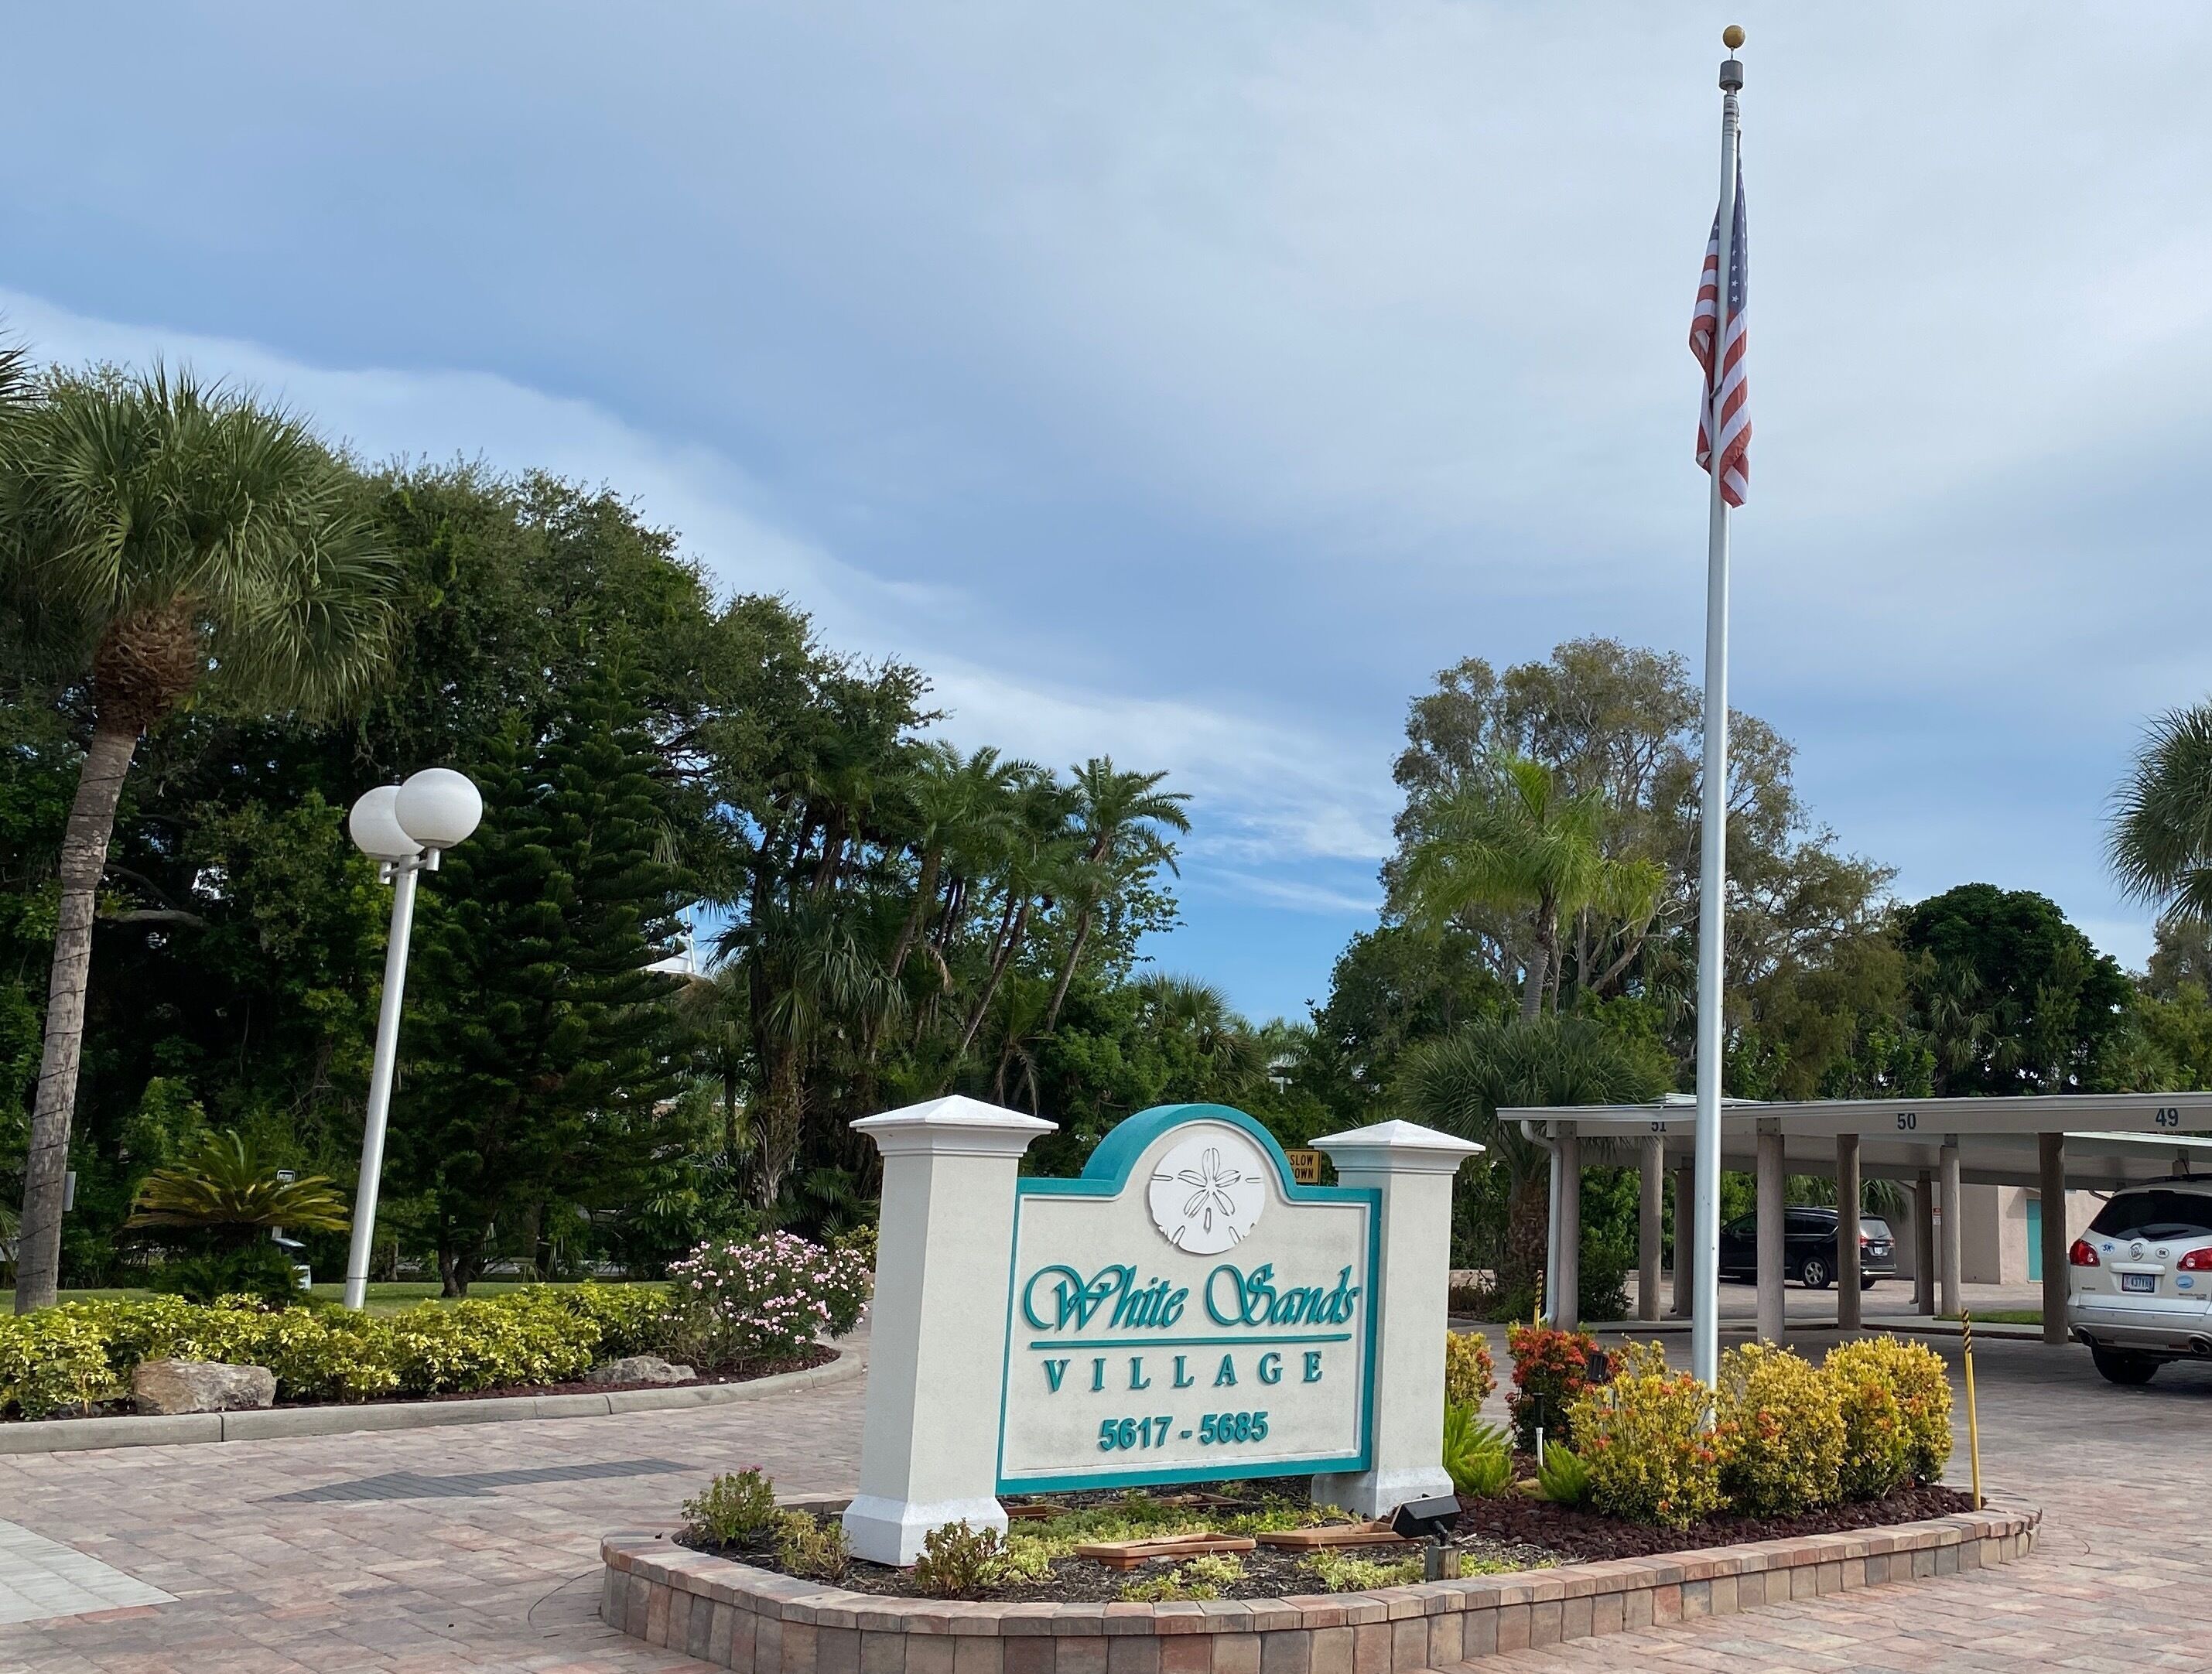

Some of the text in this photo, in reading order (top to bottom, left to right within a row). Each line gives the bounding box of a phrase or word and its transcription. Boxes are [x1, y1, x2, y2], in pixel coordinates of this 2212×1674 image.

[1897, 1113, 1916, 1129] 50
[2156, 1108, 2179, 1126] 49
[1651, 1121, 1667, 1132] 51
[1290, 1154, 1314, 1166] SLOW
[1292, 1167, 1314, 1179] OWN
[1023, 1262, 1362, 1331] White Sands
[1044, 1351, 1323, 1393] VILLAGE
[1099, 1416, 1174, 1451] 5617
[1199, 1411, 1269, 1445] 5685
